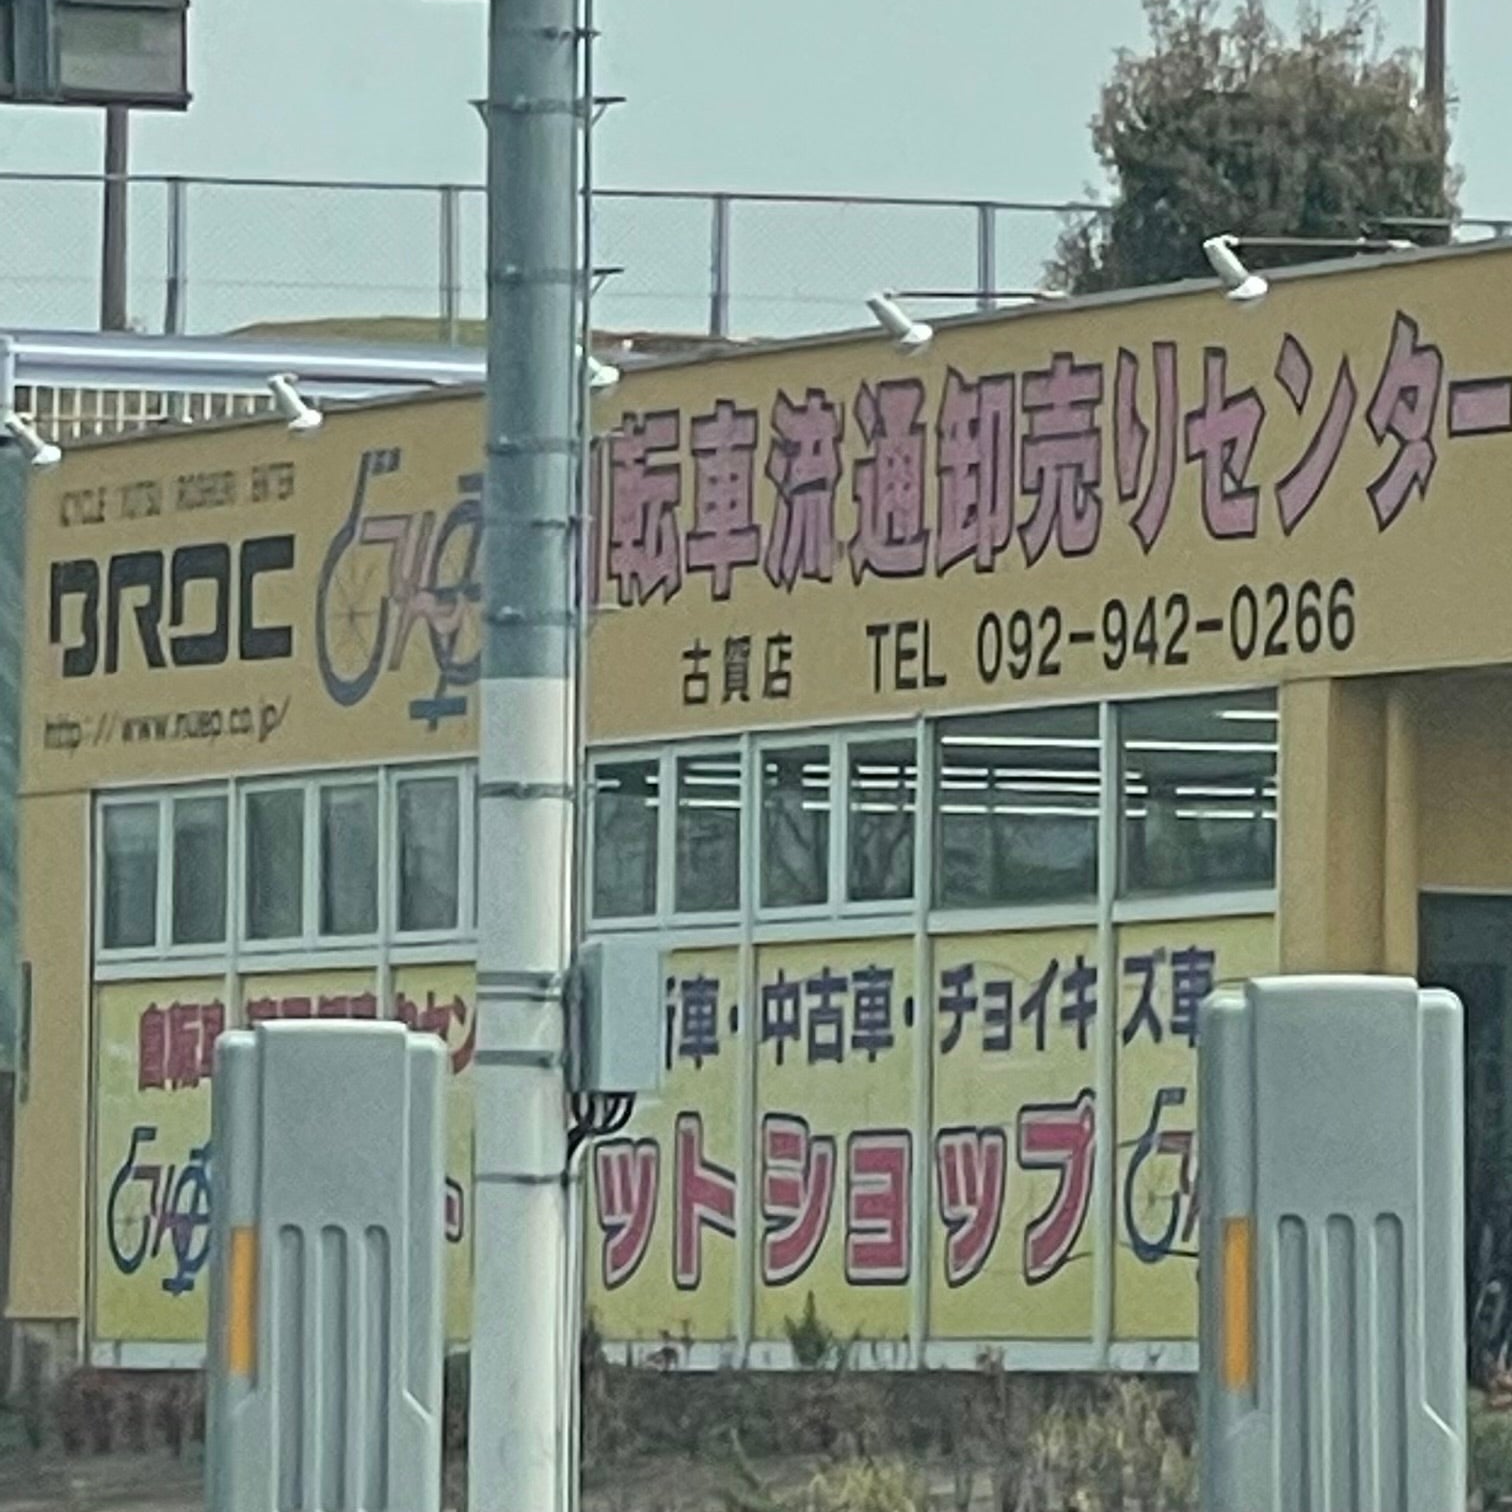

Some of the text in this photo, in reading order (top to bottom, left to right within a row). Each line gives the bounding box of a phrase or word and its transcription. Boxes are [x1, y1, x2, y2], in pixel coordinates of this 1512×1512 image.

[49, 533, 296, 678] BROC
[682, 578, 1355, 706] 古賀店 TEL 092-942-0266
[665, 946, 1215, 1070] 車・中古車・チョイキズ車
